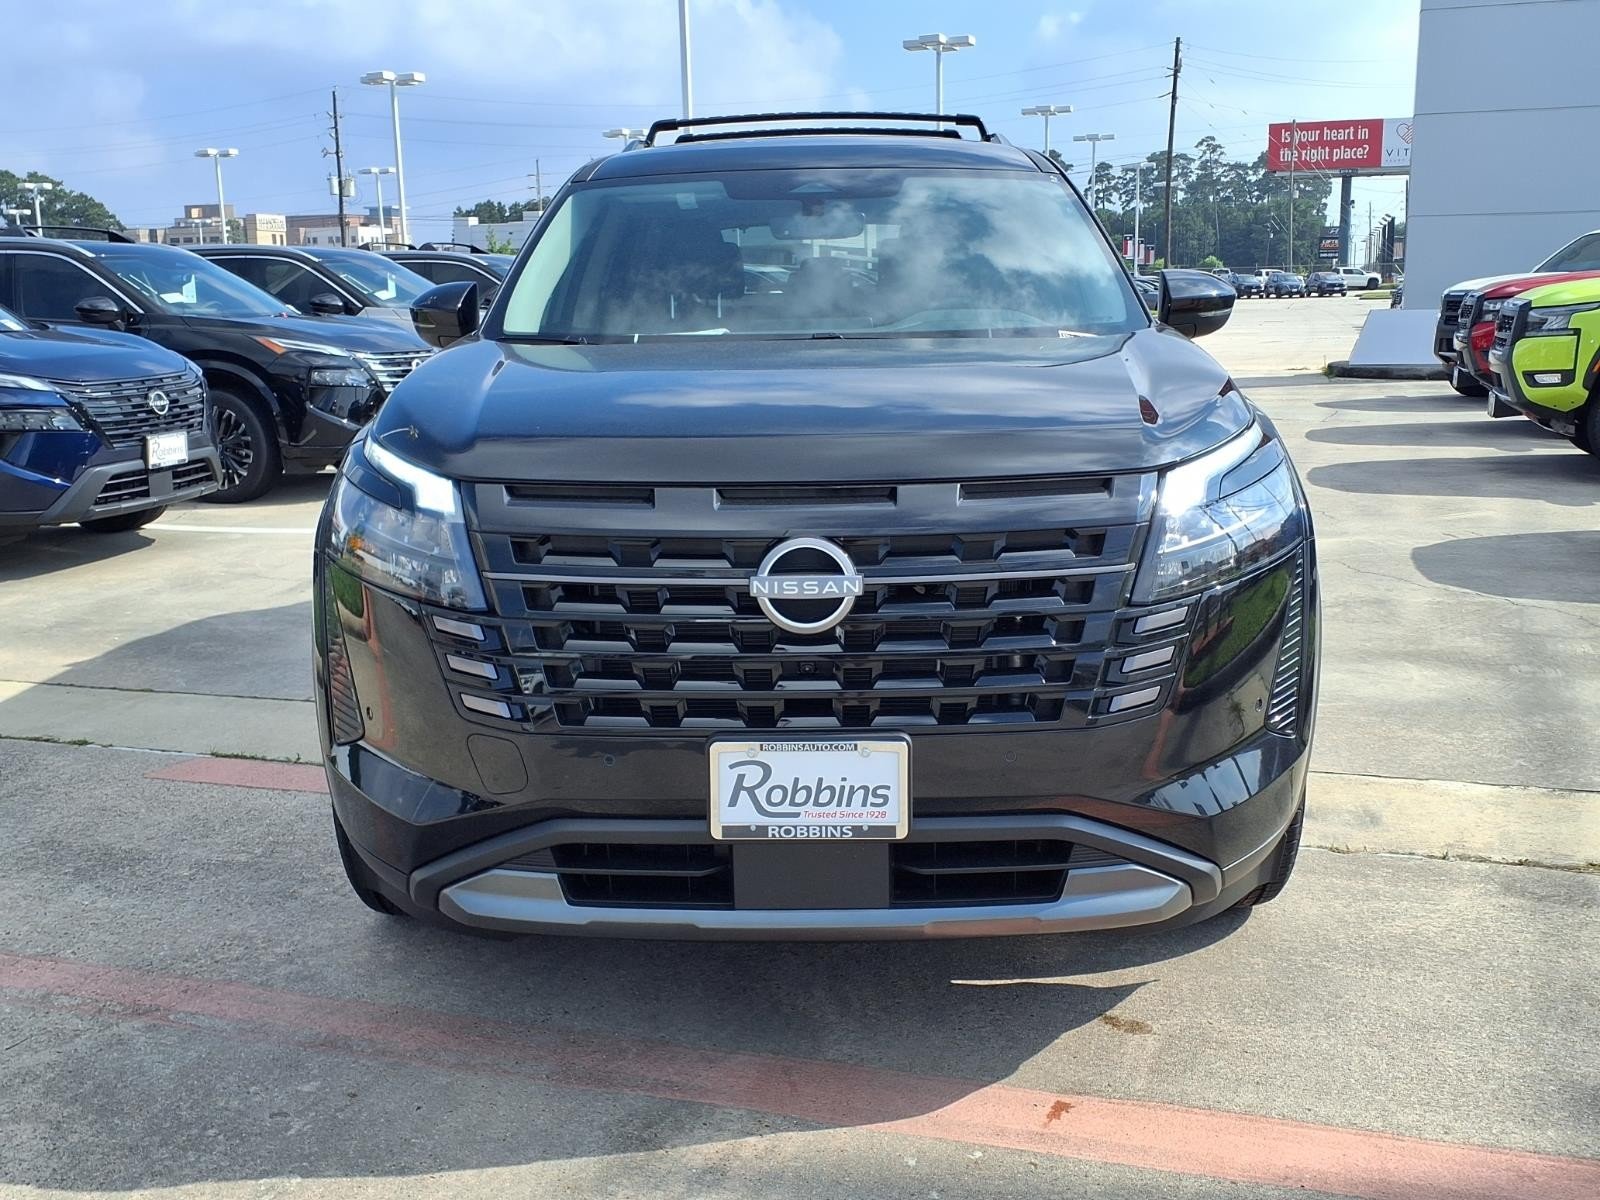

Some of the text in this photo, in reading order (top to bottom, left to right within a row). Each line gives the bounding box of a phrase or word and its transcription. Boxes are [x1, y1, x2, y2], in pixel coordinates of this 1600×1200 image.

[1281, 125, 1369, 144] Is your heart in
[1280, 144, 1370, 163] the right place?
[1386, 148, 1410, 157] VIT
[752, 580, 860, 594] NISSAN
[762, 743, 855, 751] ROBBINSAUTO.COM
[727, 760, 891, 818] Robbins
[767, 826, 853, 838] ROBBINS
